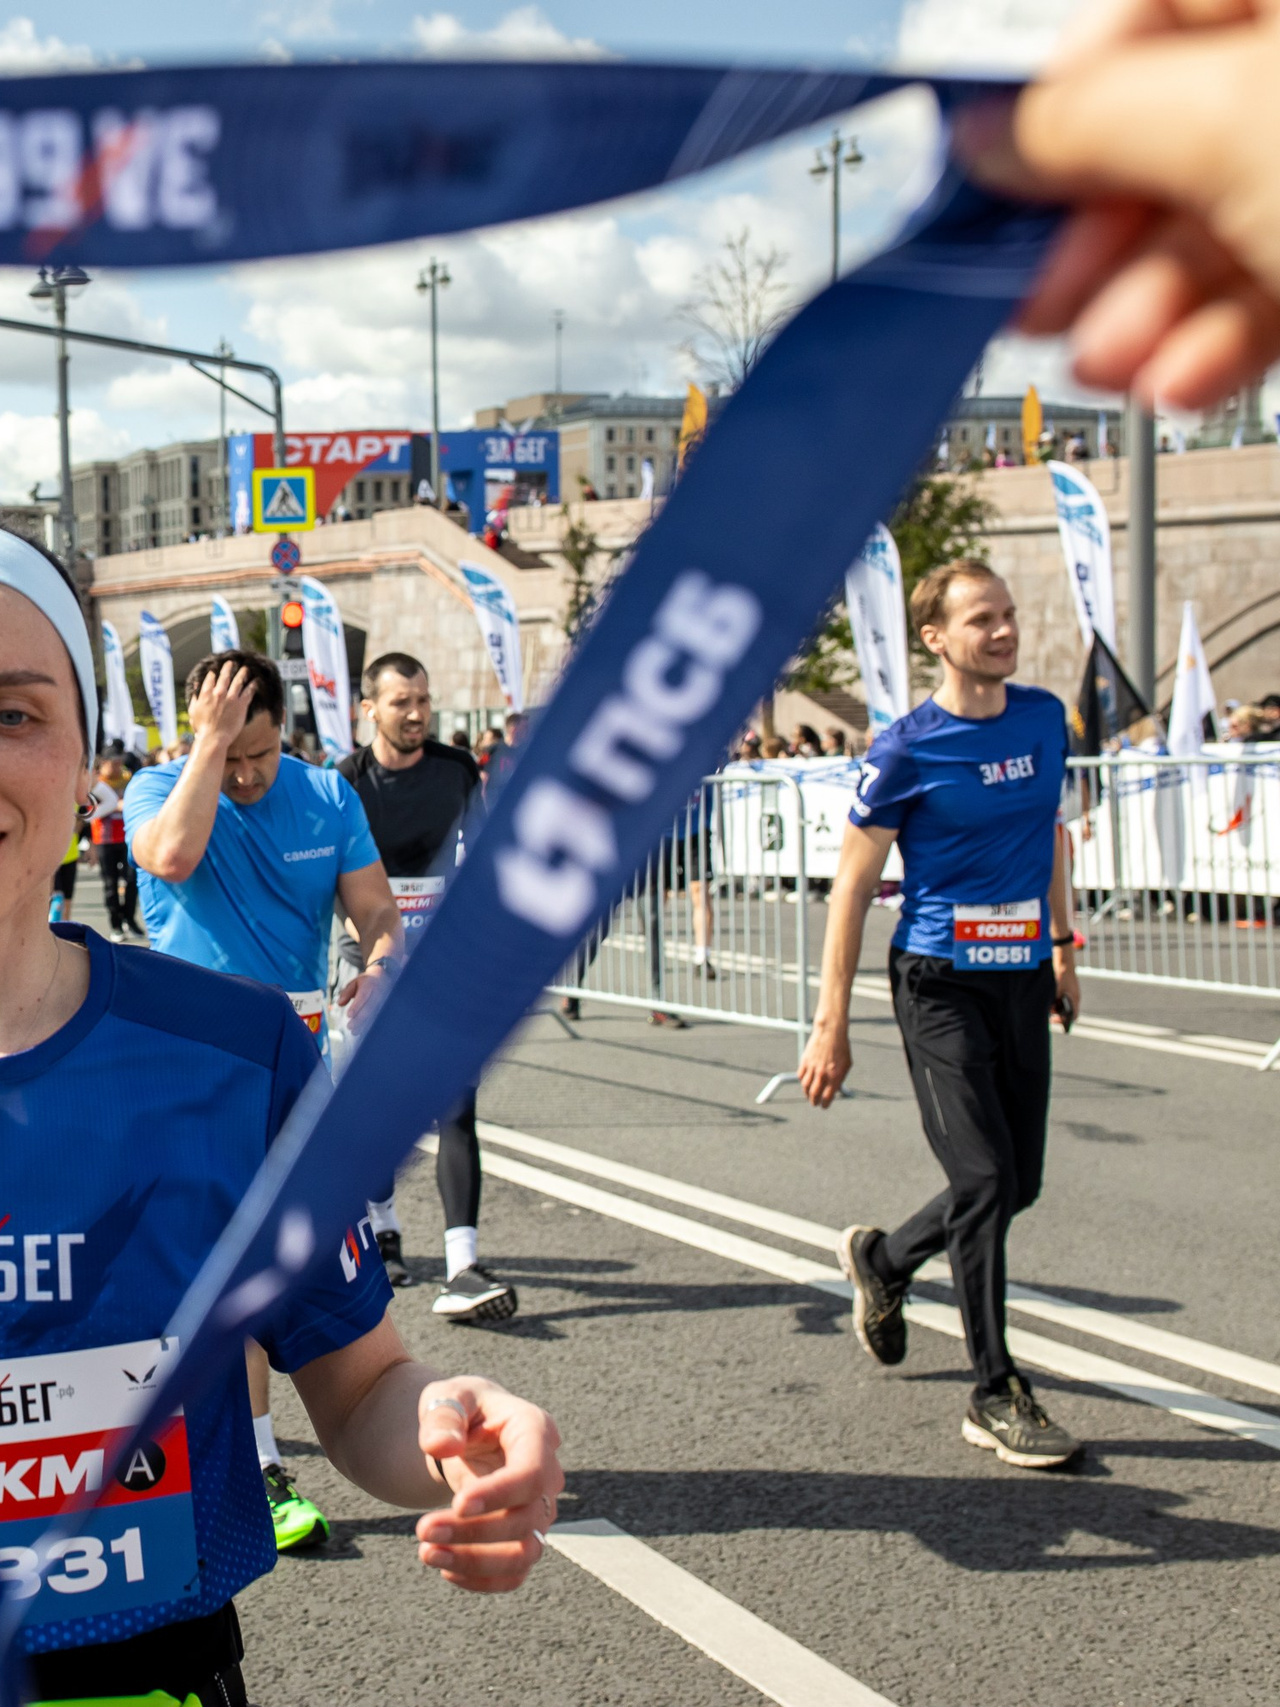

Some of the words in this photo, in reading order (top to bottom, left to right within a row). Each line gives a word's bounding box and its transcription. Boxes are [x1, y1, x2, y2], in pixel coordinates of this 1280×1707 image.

[284, 435, 412, 464] СТАРТ
[567, 570, 762, 803] ПСБ
[283, 845, 337, 863] самолет
[965, 946, 1032, 965] 10551
